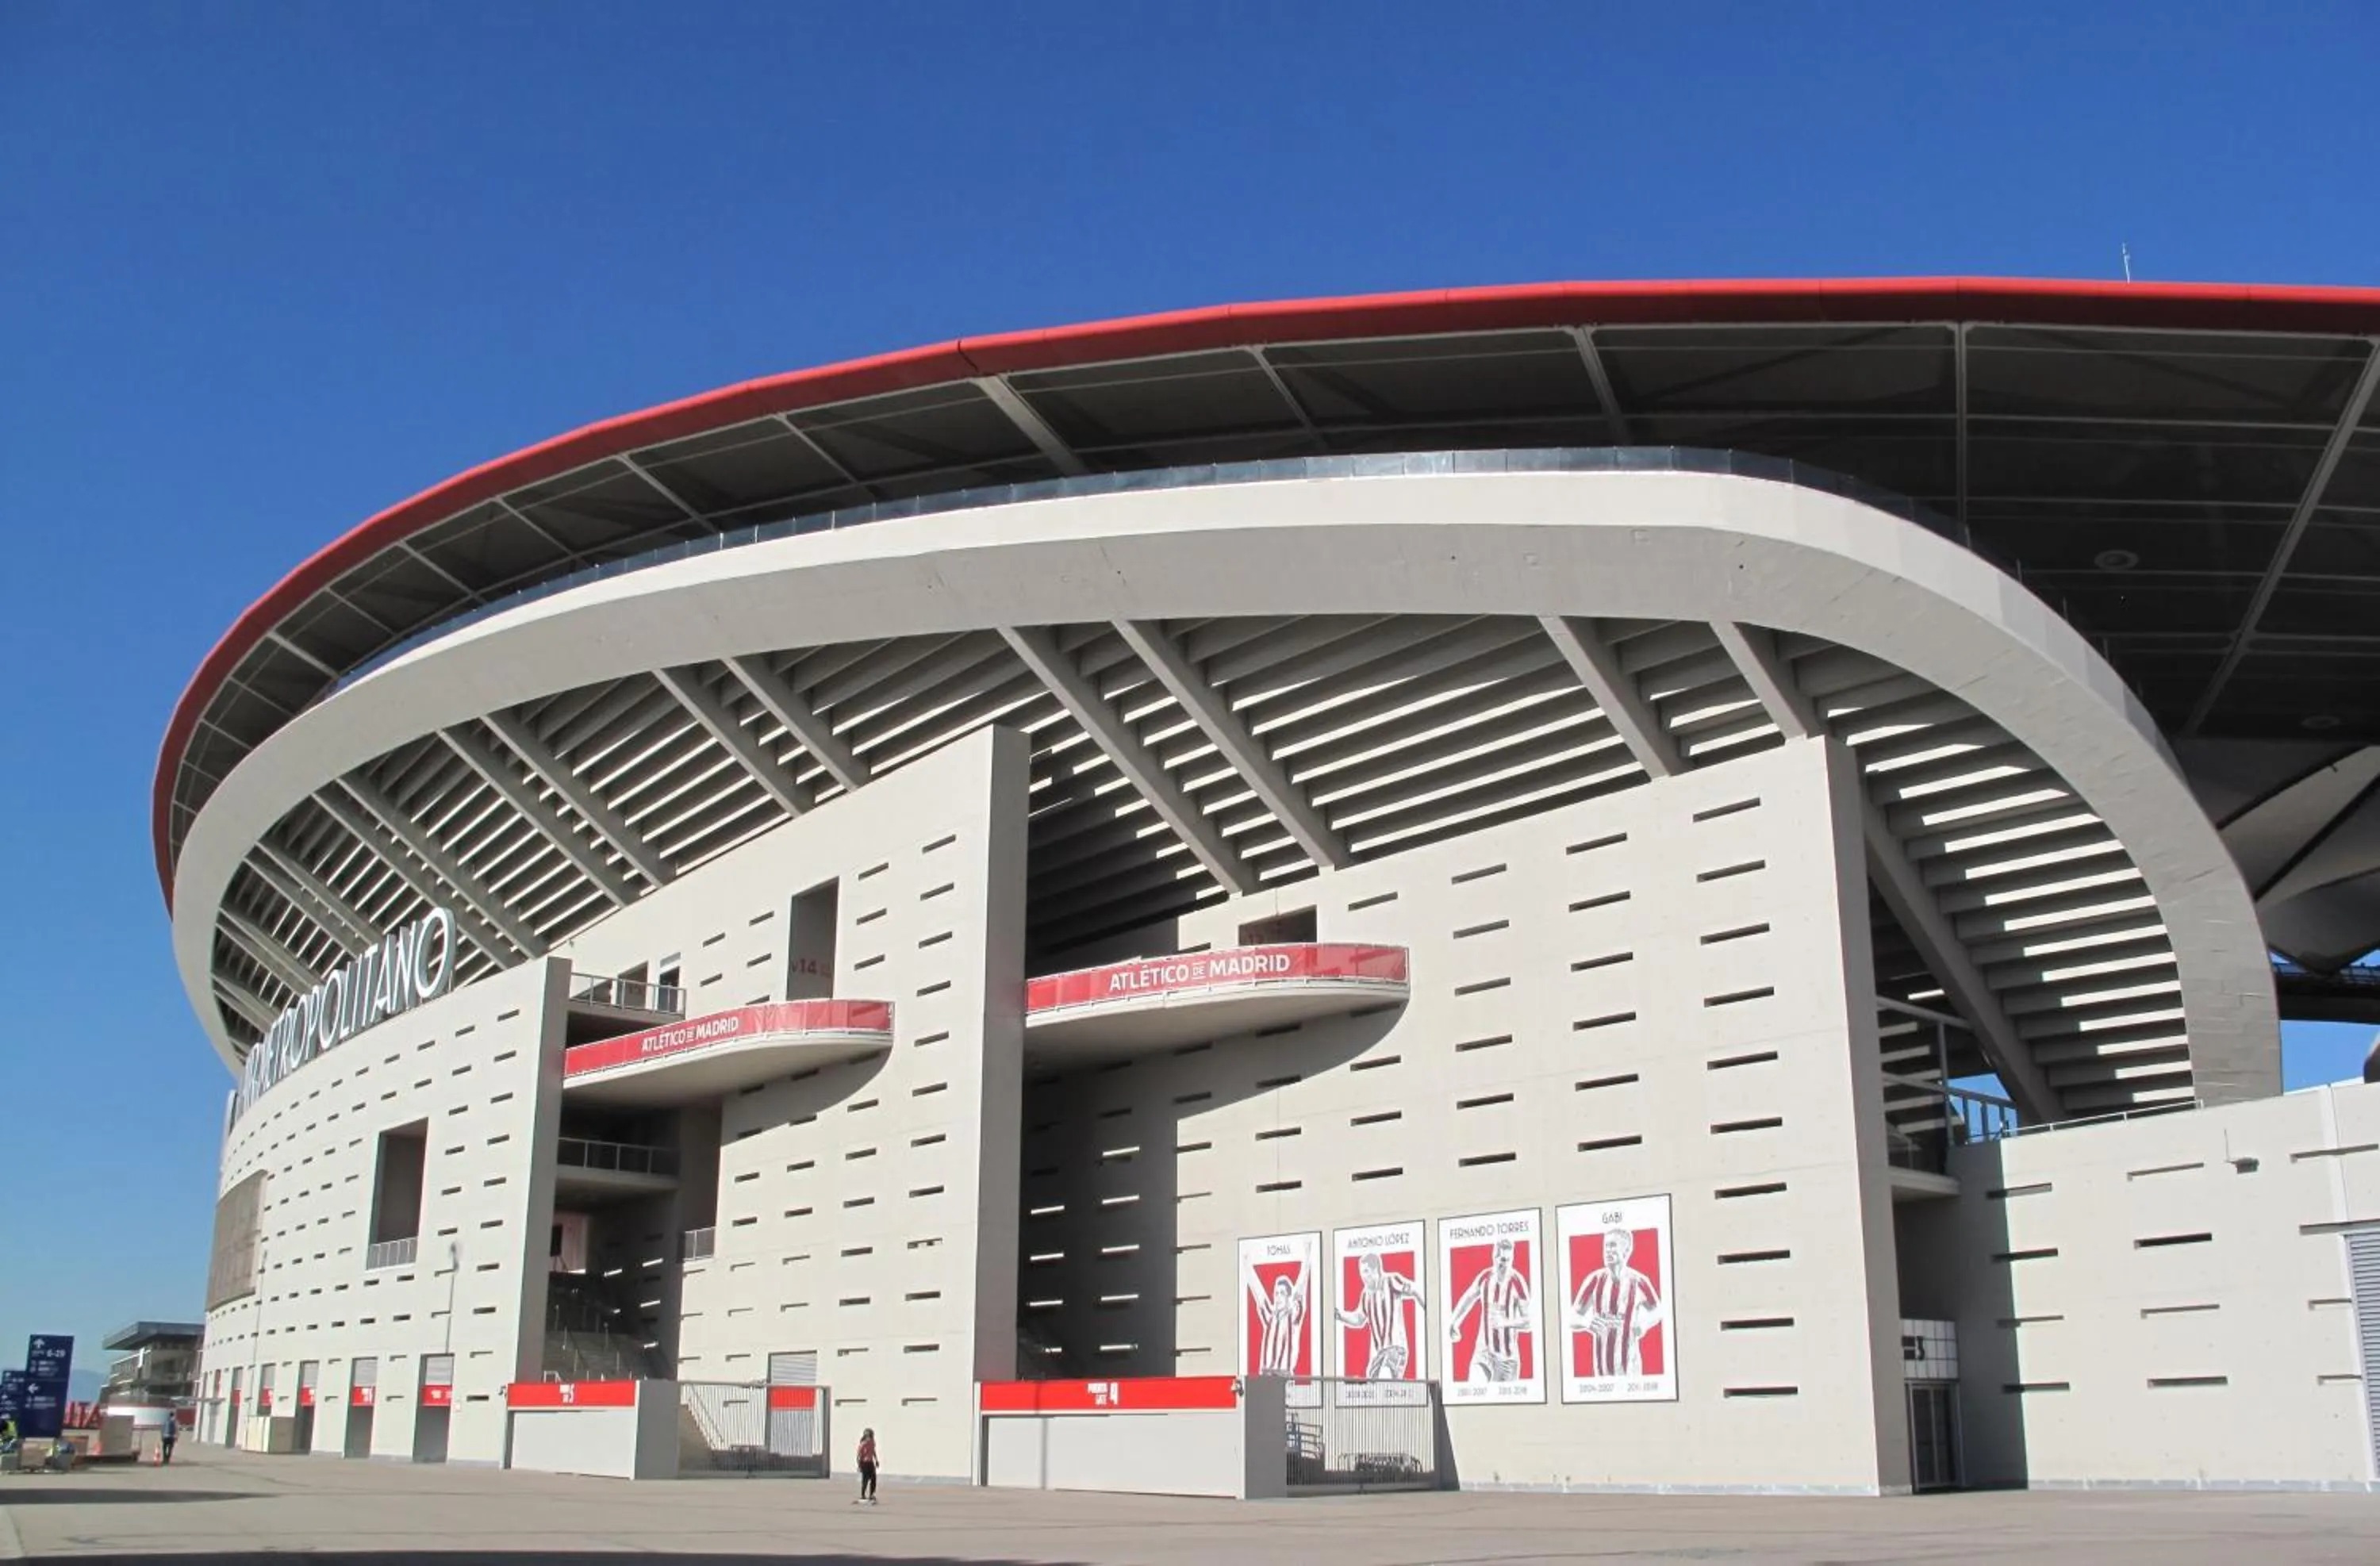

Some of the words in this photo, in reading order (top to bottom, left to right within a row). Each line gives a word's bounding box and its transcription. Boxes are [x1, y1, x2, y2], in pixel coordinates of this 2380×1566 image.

[1109, 963, 1189, 992] ATLÉTICO
[1209, 954, 1290, 978] MADRID
[643, 1028, 686, 1052] ATLÉTICO
[695, 1016, 739, 1039] MADRID
[1449, 1223, 1495, 1239] FERNANDO
[1497, 1220, 1530, 1235] TORRES
[1602, 1211, 1622, 1224] GABI
